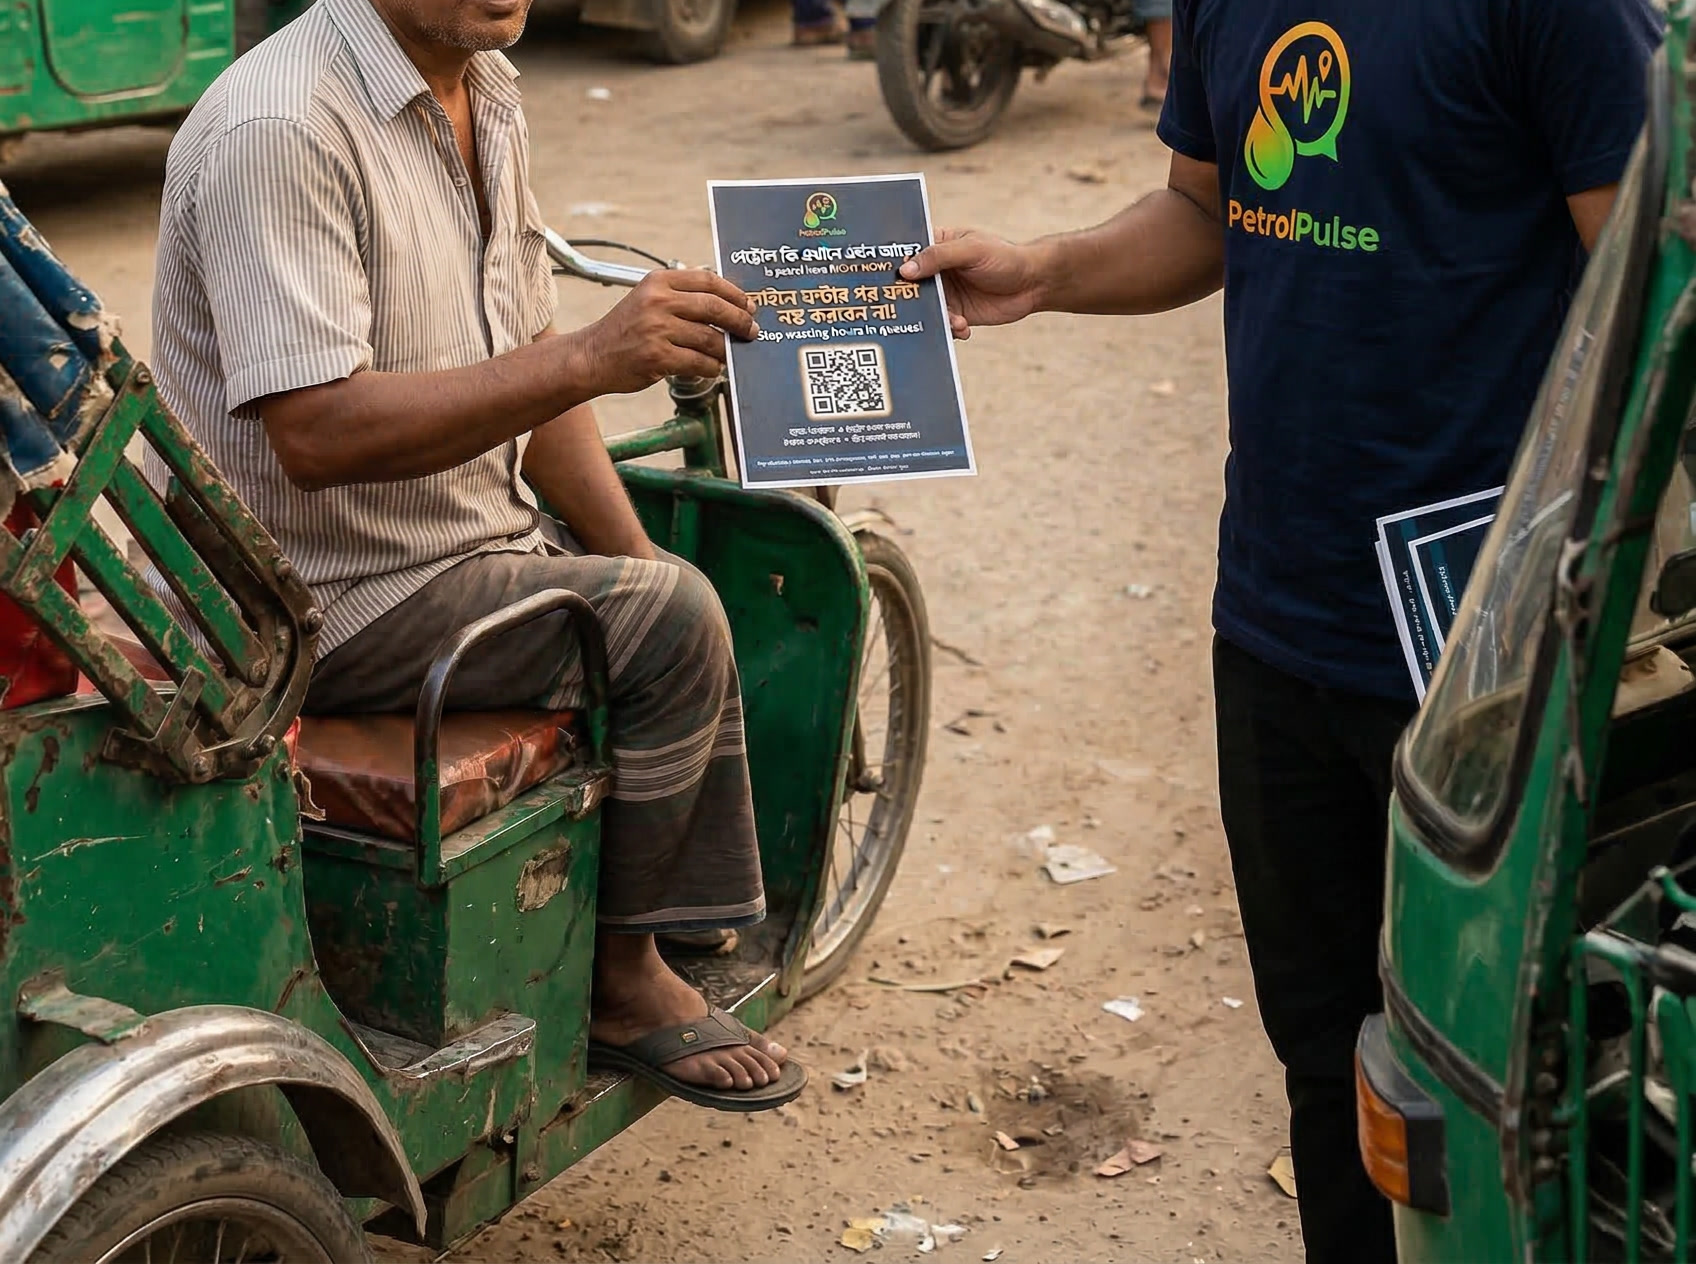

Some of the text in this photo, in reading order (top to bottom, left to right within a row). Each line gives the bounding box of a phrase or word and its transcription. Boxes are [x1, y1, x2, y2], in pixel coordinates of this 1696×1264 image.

[1229, 199, 1380, 252] PetrolPulse
[863, 261, 893, 272] NOW?
[854, 284, 879, 303] পর
[872, 303, 897, 320] না!
